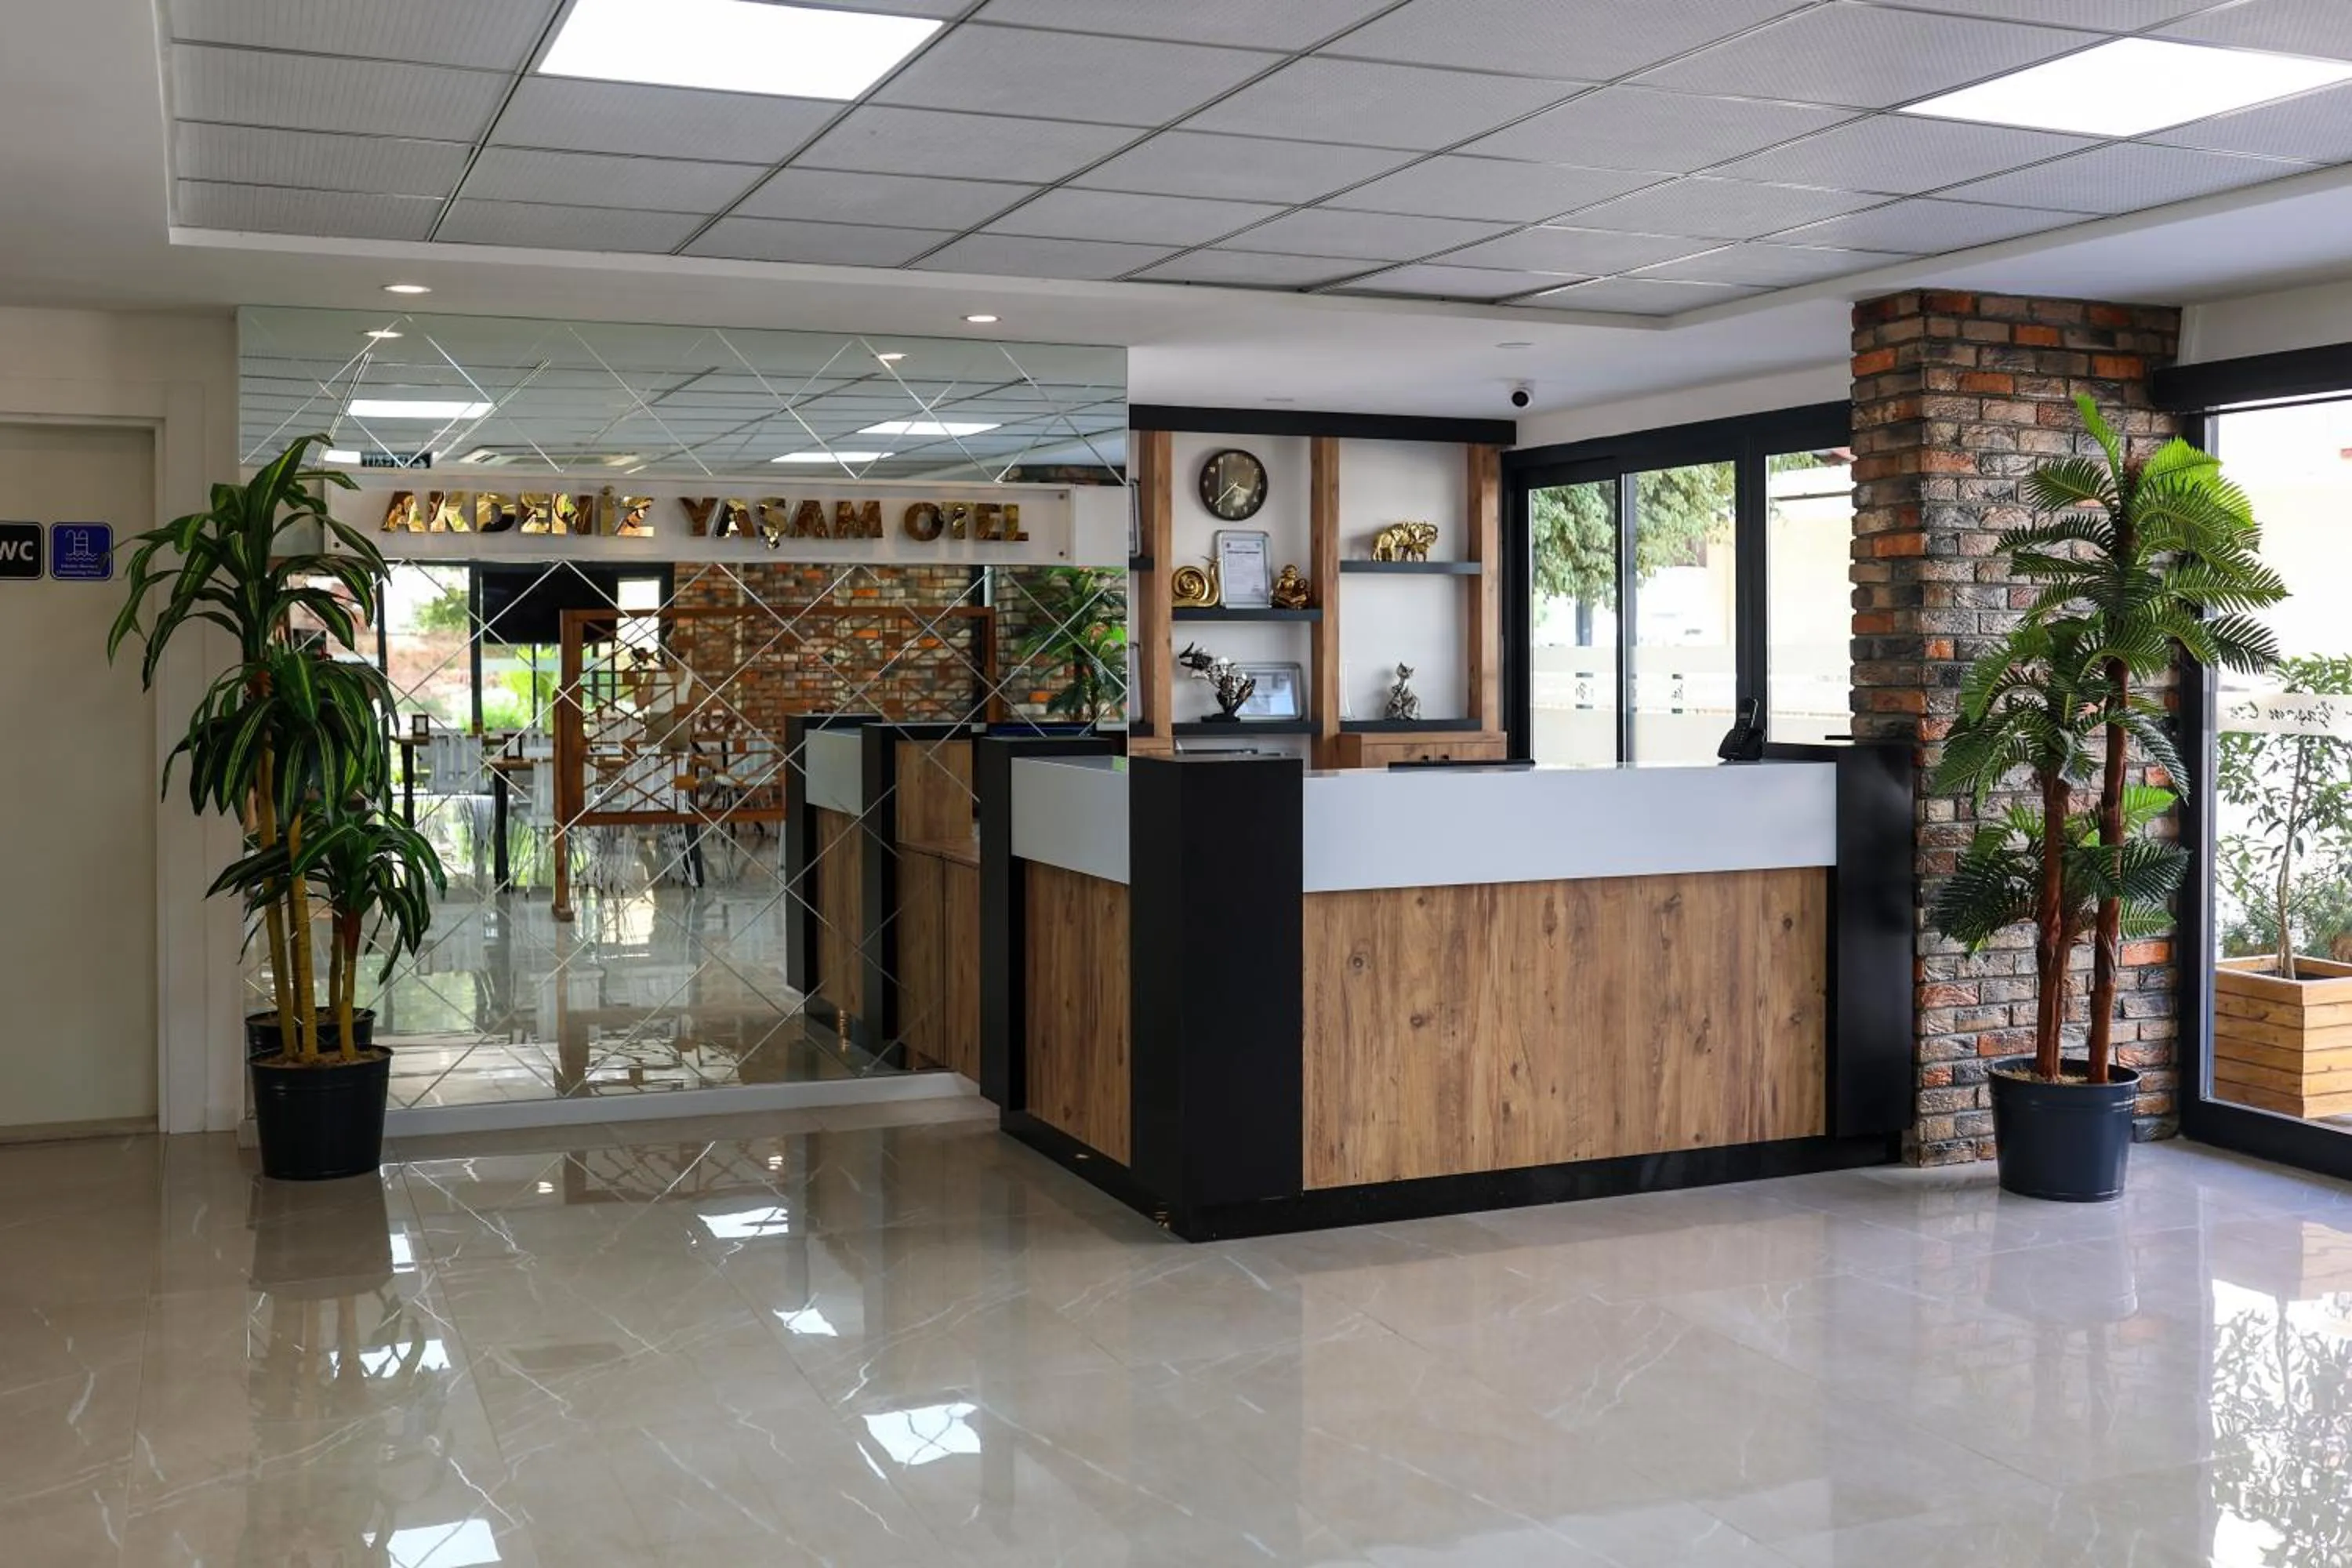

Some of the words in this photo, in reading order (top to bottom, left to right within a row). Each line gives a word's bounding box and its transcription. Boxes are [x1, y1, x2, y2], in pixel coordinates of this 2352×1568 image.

[381, 485, 655, 537] AKDENİZ
[678, 496, 884, 550] YAŞAM
[904, 500, 1029, 542] OTEL
[0, 540, 34, 561] WC
